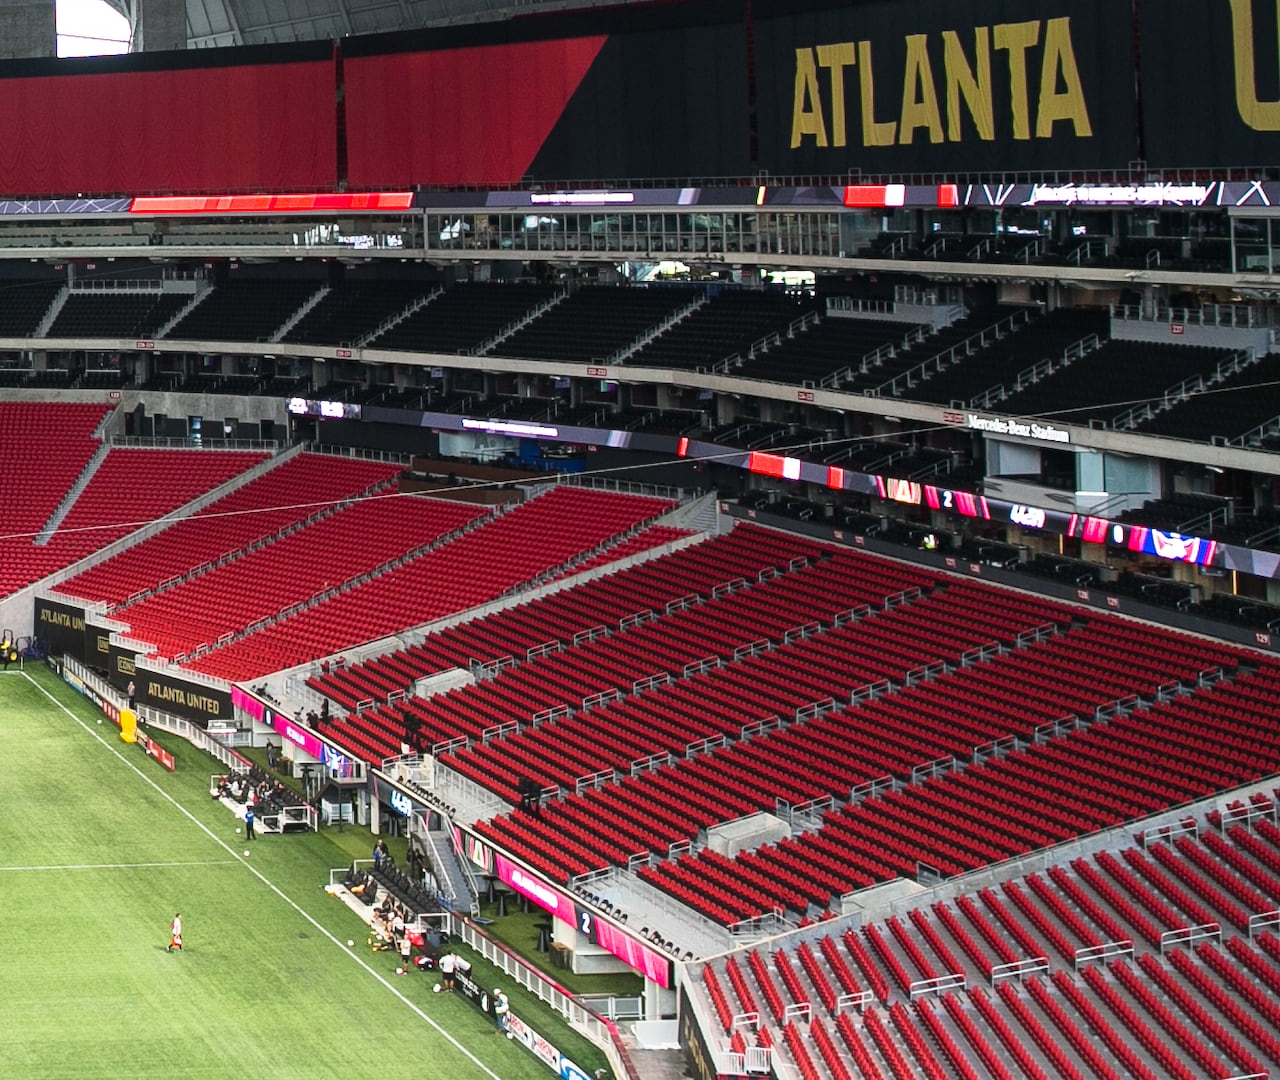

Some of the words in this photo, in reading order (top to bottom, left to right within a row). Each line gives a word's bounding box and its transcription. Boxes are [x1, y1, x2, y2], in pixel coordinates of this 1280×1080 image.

[790, 17, 1093, 148] ATLANTA
[968, 414, 1031, 436] Mercedes-Benz
[1031, 423, 1070, 443] Stadium
[943, 491, 952, 507] 2
[40, 608, 71, 628] ATLANTA
[1256, 633, 1269, 644] 129
[148, 682, 185, 705] ATLANTA
[187, 692, 220, 715] UNITED
[582, 912, 590, 934] 2
